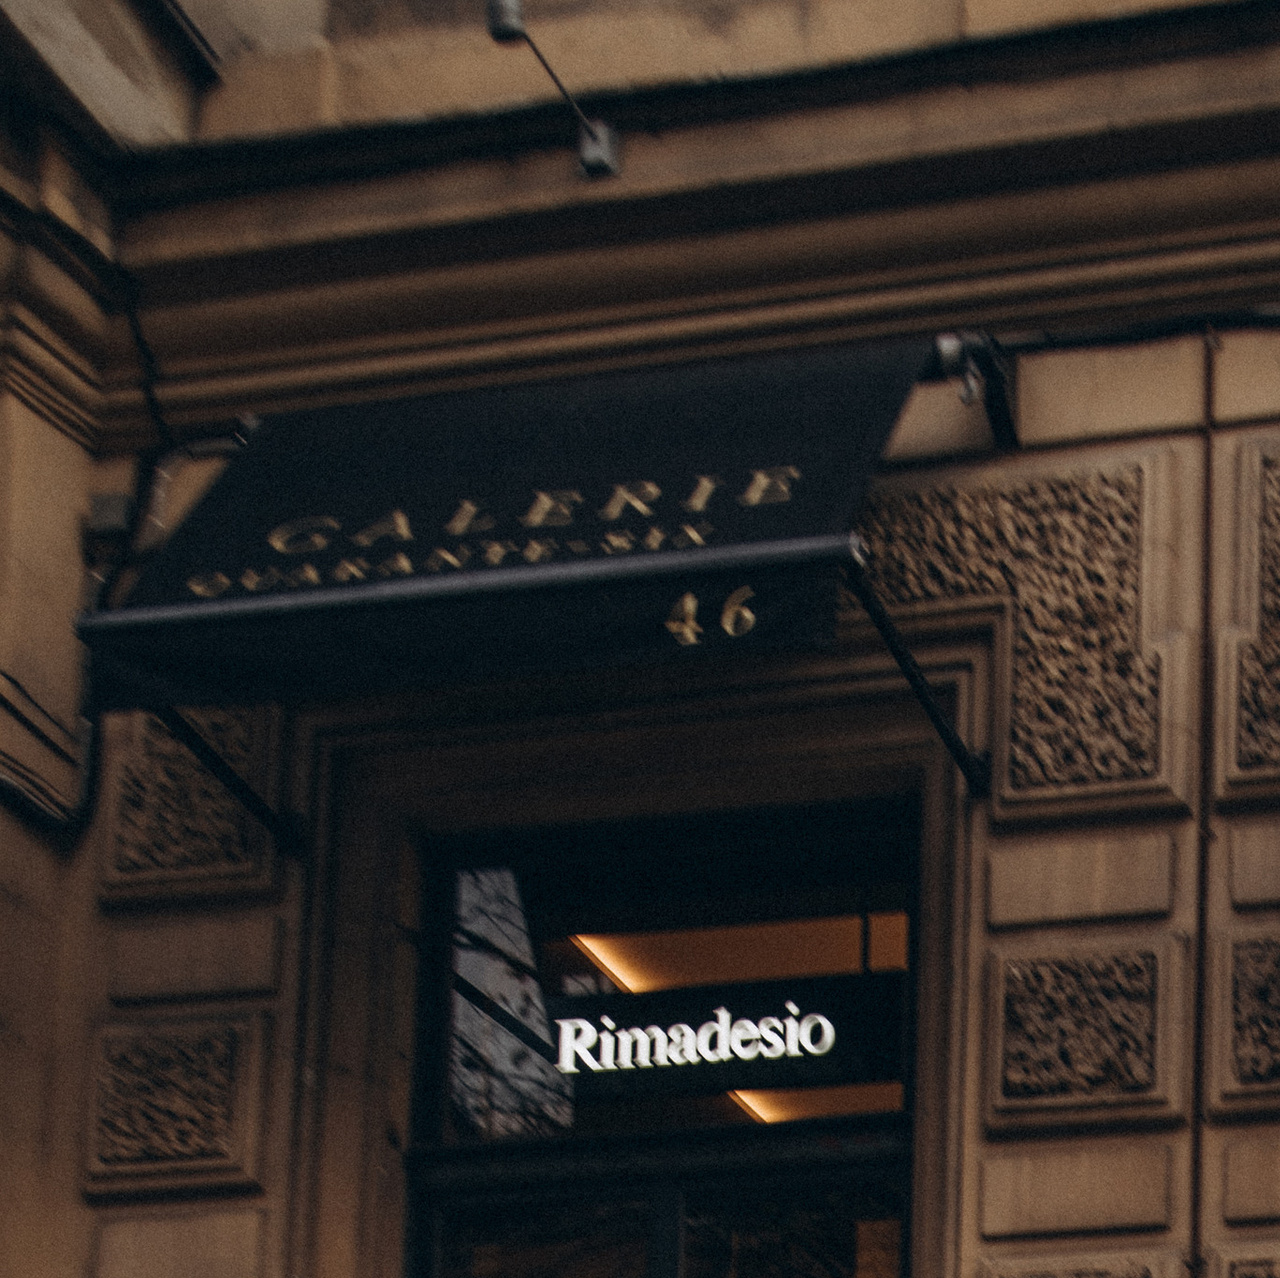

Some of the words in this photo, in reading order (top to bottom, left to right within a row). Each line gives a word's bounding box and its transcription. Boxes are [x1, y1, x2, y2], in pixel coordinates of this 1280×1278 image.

[266, 464, 800, 555] GALERIE
[664, 585, 758, 647] 46
[552, 999, 837, 1074] Rimadesio
